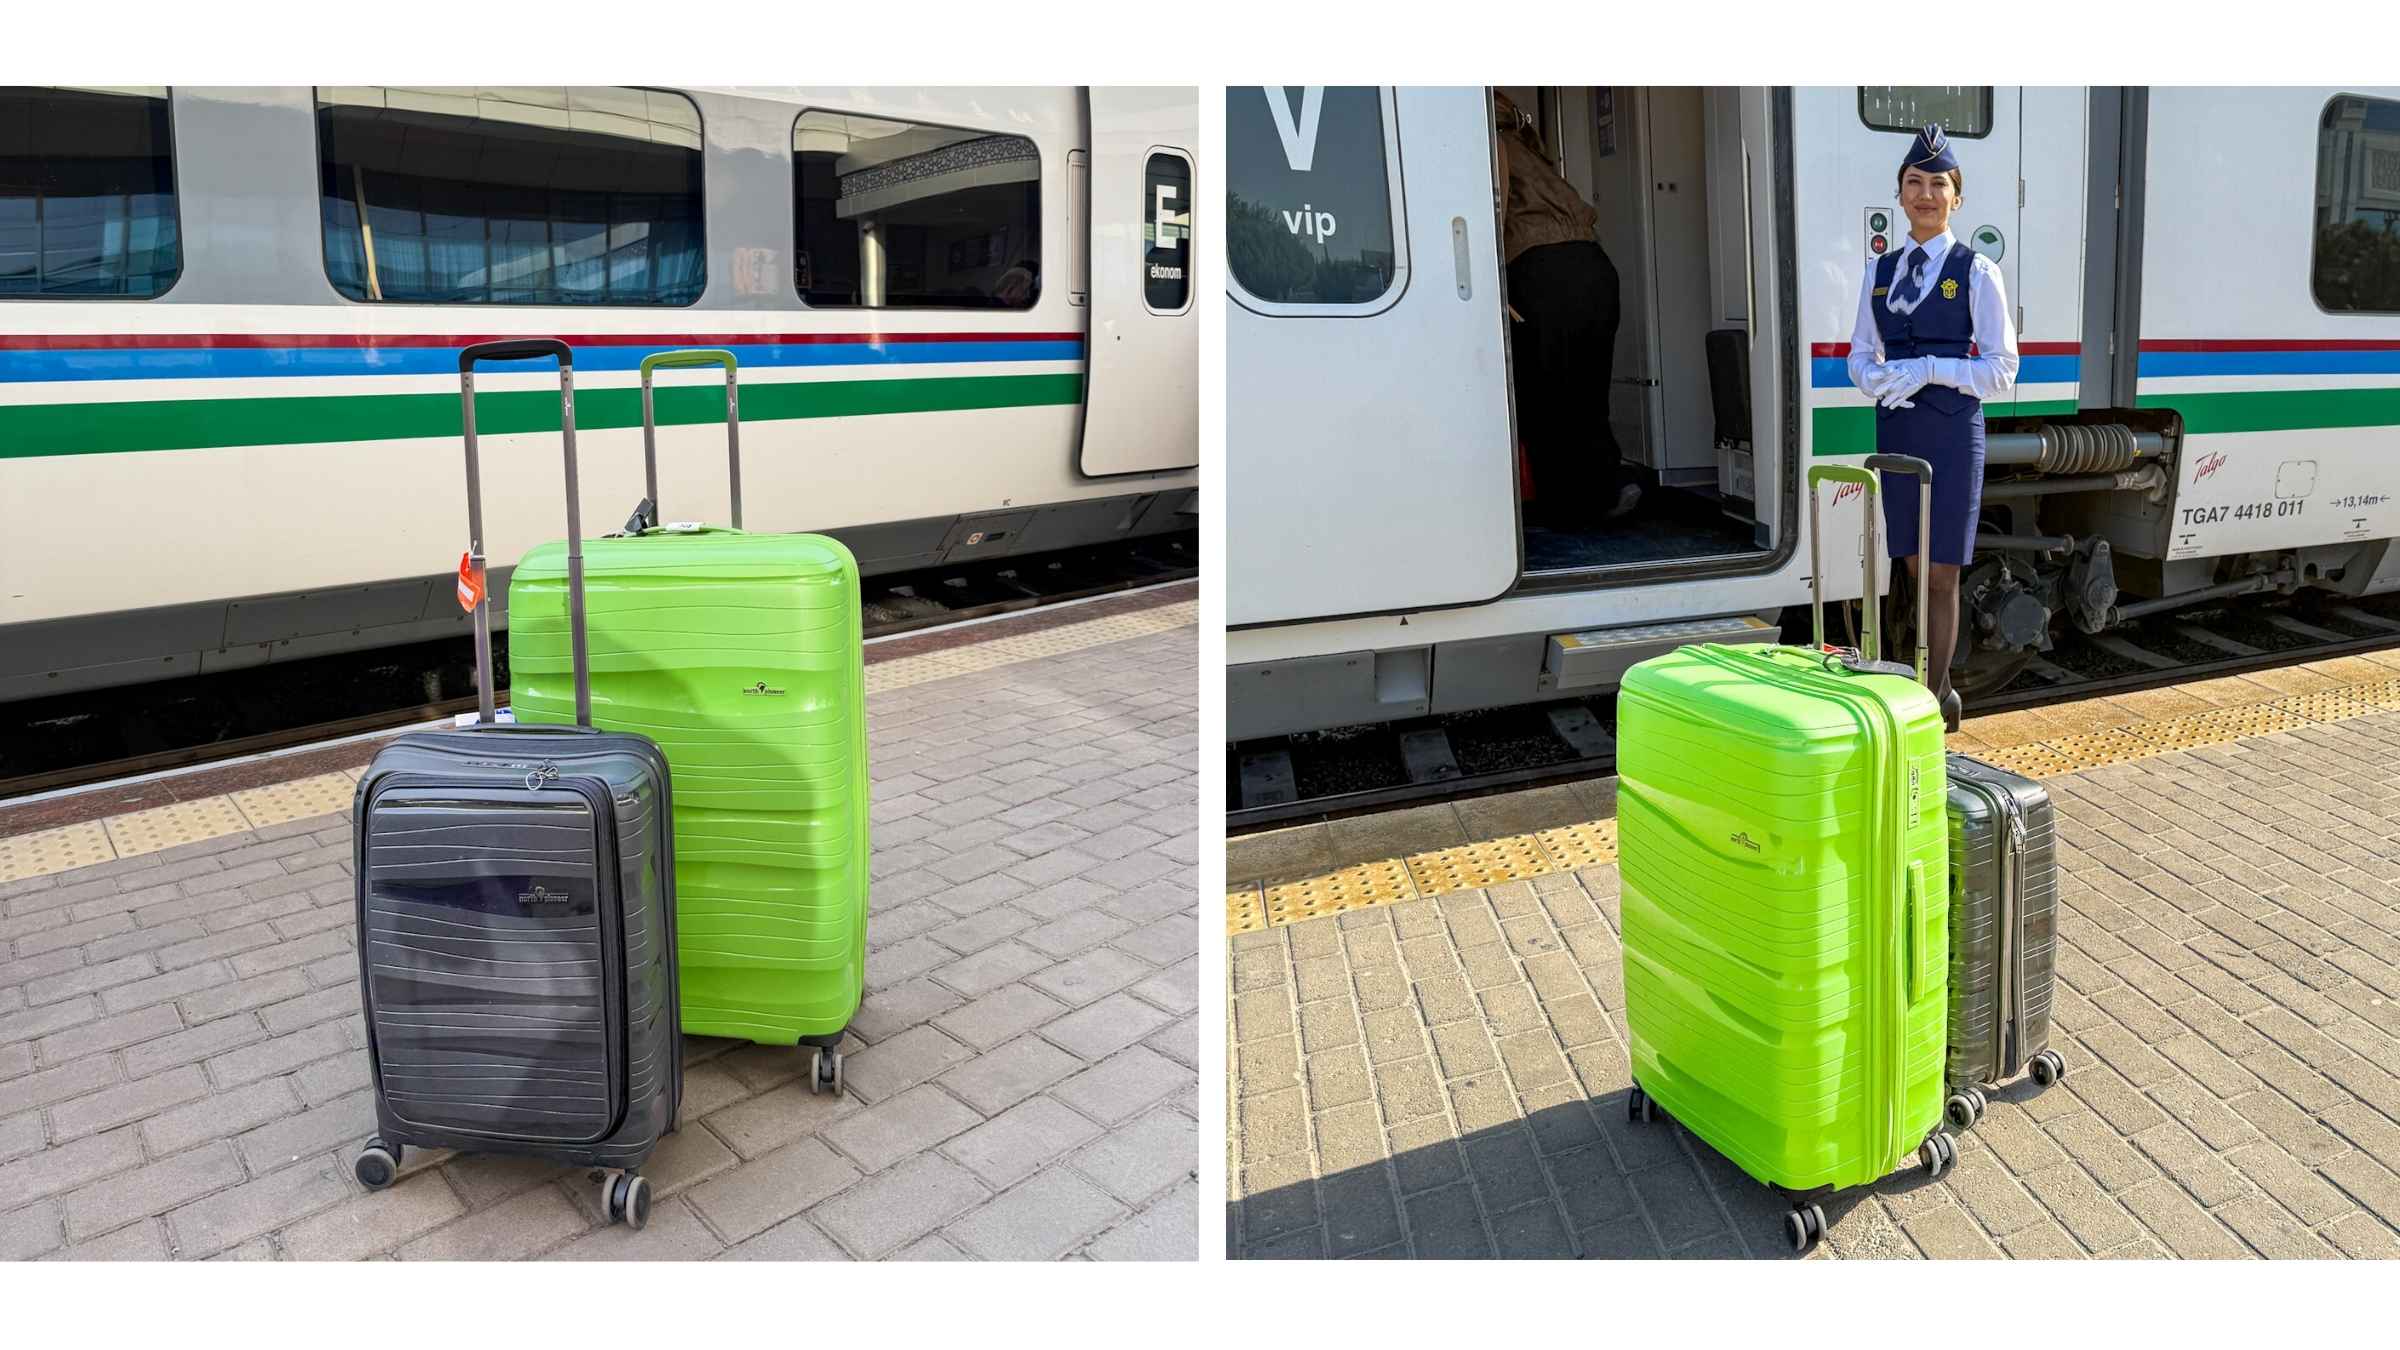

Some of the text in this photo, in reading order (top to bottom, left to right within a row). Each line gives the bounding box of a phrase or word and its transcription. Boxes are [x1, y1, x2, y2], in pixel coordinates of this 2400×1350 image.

[1263, 86, 1325, 171] V
[1155, 184, 1177, 249] E
[1283, 204, 1337, 244] vip
[1150, 263, 1182, 279] ekonom
[2193, 451, 2228, 484] Talgo
[1832, 481, 1864, 507] Talg
[2343, 495, 2379, 508] 13,14m
[2182, 499, 2304, 525] TGA7 4418 011
